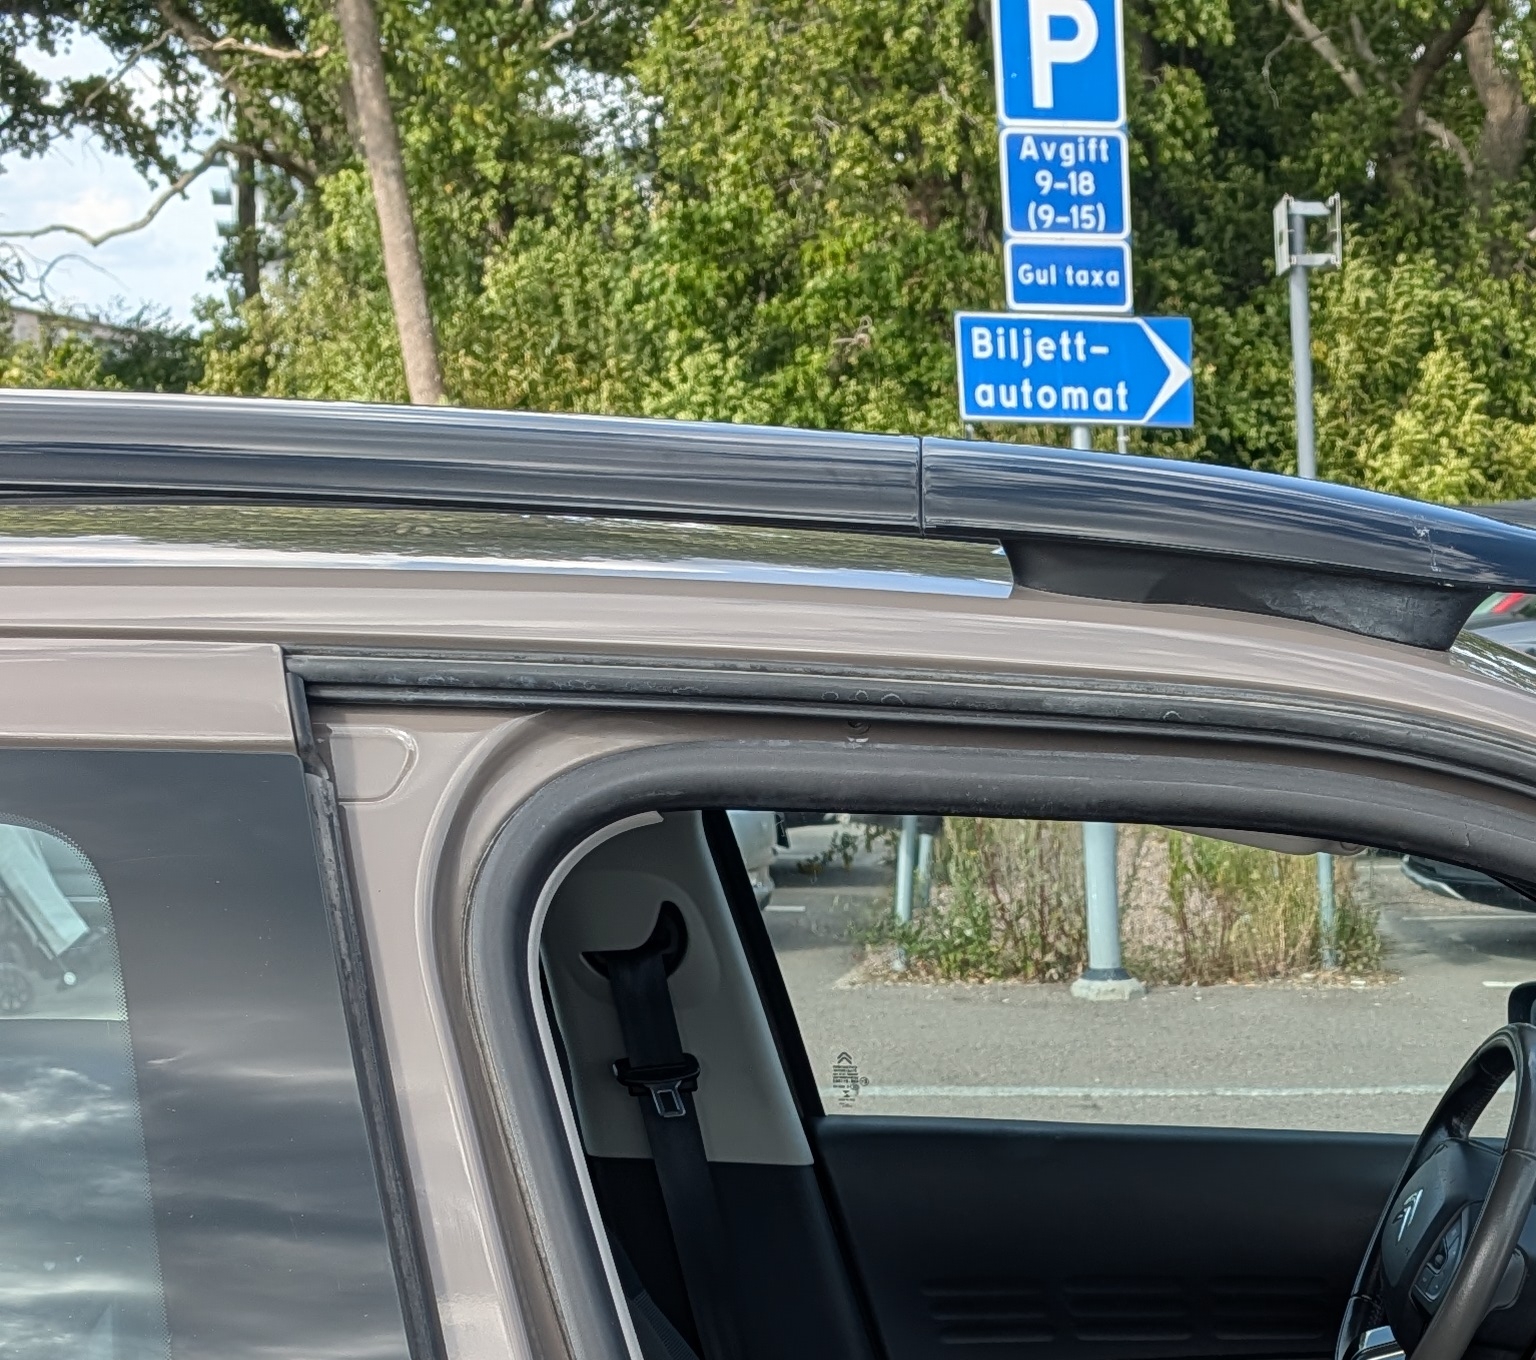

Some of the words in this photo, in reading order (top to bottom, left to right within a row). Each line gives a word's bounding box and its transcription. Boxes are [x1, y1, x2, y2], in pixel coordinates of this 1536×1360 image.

[1028, 0, 1099, 109] P
[1019, 135, 1110, 167] Avgift
[1034, 169, 1096, 197] 9-18
[1027, 202, 1107, 233] (9-15)
[1017, 263, 1058, 286] Gul
[1065, 265, 1121, 287] taxa
[970, 326, 1110, 368] Biljett-
[974, 377, 1129, 411] automat
